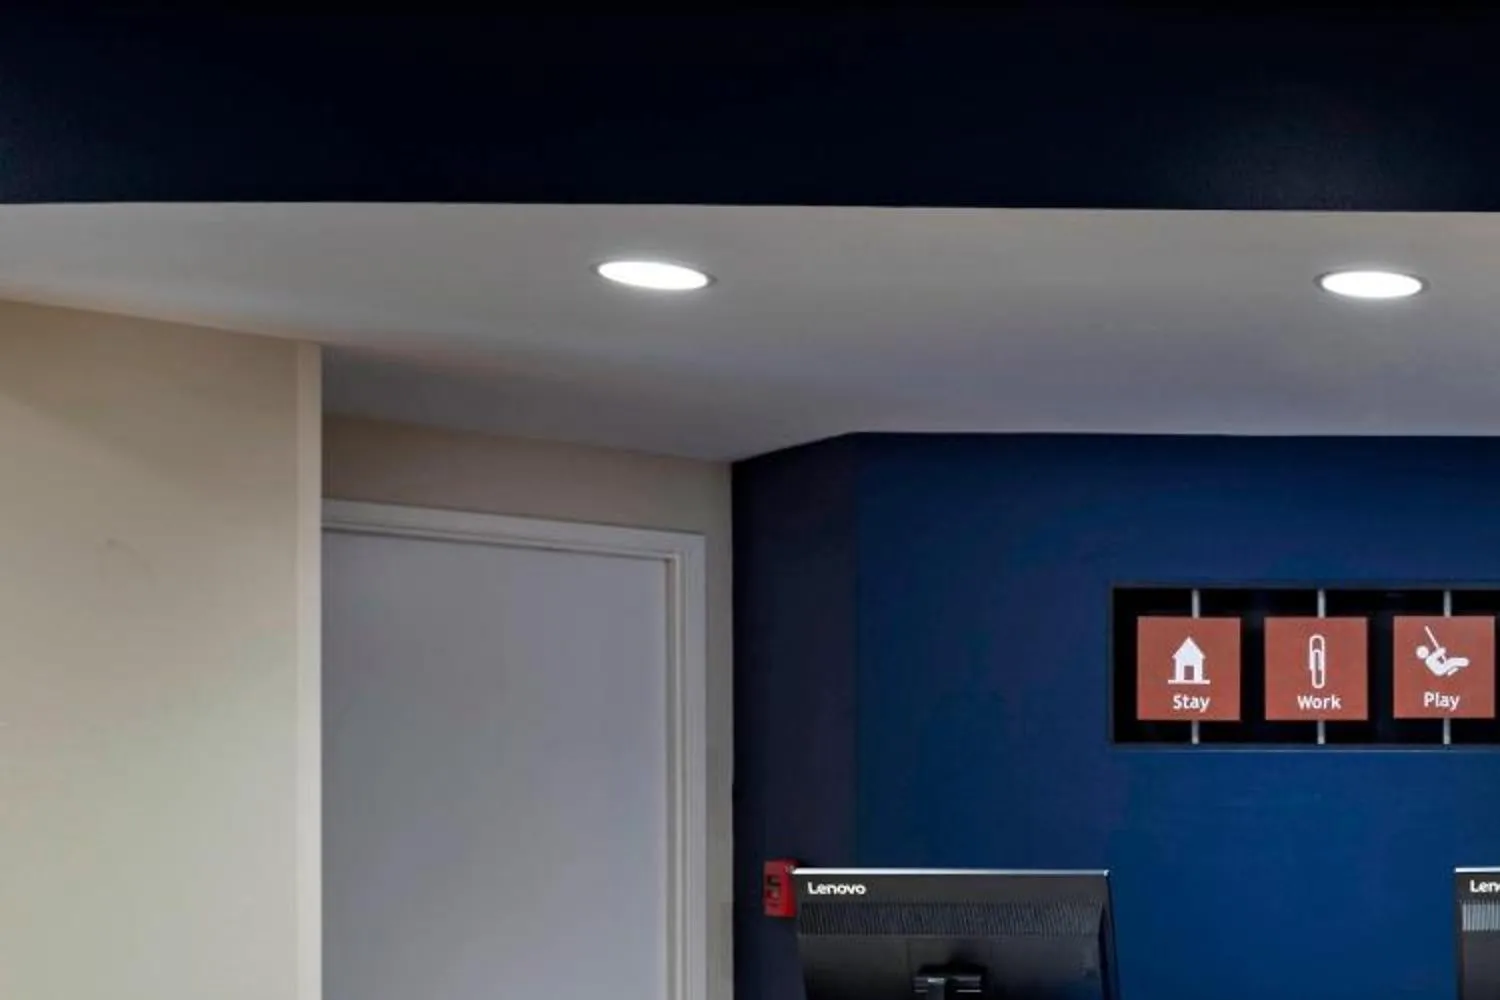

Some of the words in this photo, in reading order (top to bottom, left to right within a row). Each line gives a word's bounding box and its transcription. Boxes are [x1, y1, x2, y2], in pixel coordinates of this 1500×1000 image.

[1172, 694, 1211, 712] Stay
[1296, 694, 1342, 710] Work
[1423, 691, 1460, 712] Play
[806, 881, 867, 895] Lenovo
